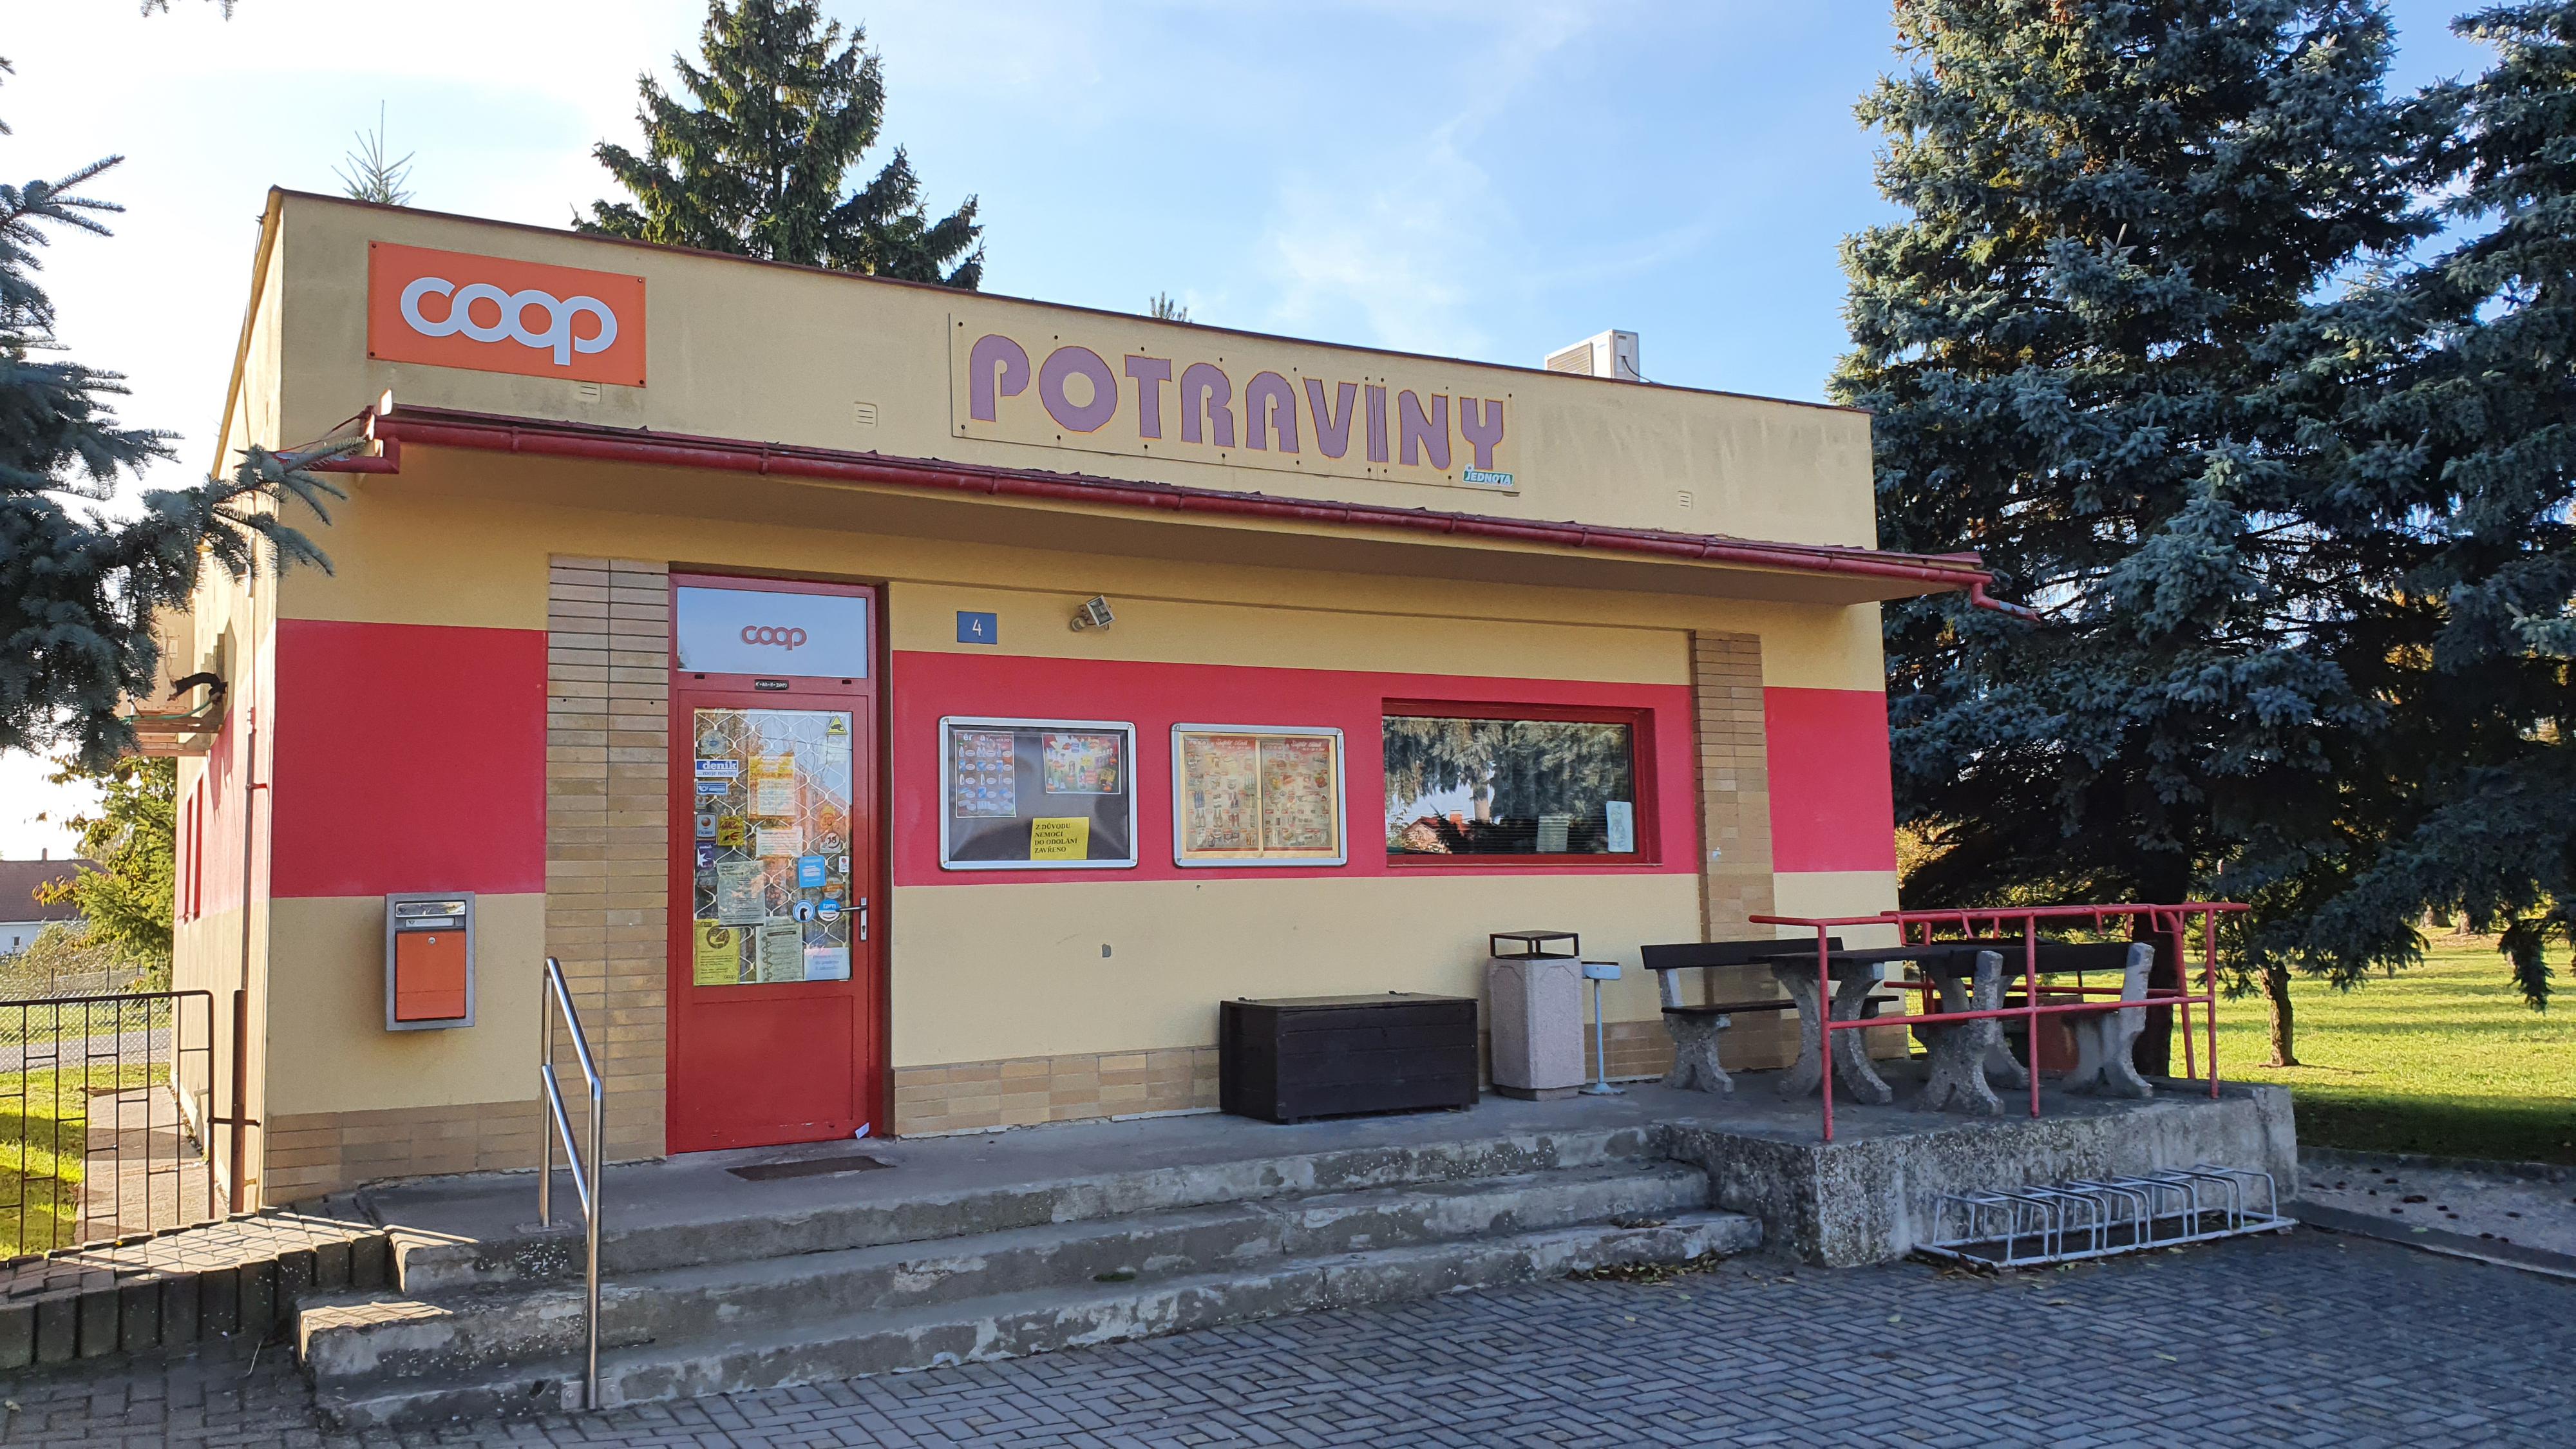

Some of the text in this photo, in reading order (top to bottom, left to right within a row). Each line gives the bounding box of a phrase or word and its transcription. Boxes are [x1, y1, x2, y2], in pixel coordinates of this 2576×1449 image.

[400, 276, 618, 366] coop
[969, 333, 1504, 471] POTRAVINY
[1464, 470, 1511, 486] JEDNOTA
[741, 625, 808, 651] coop
[972, 618, 982, 636] 4
